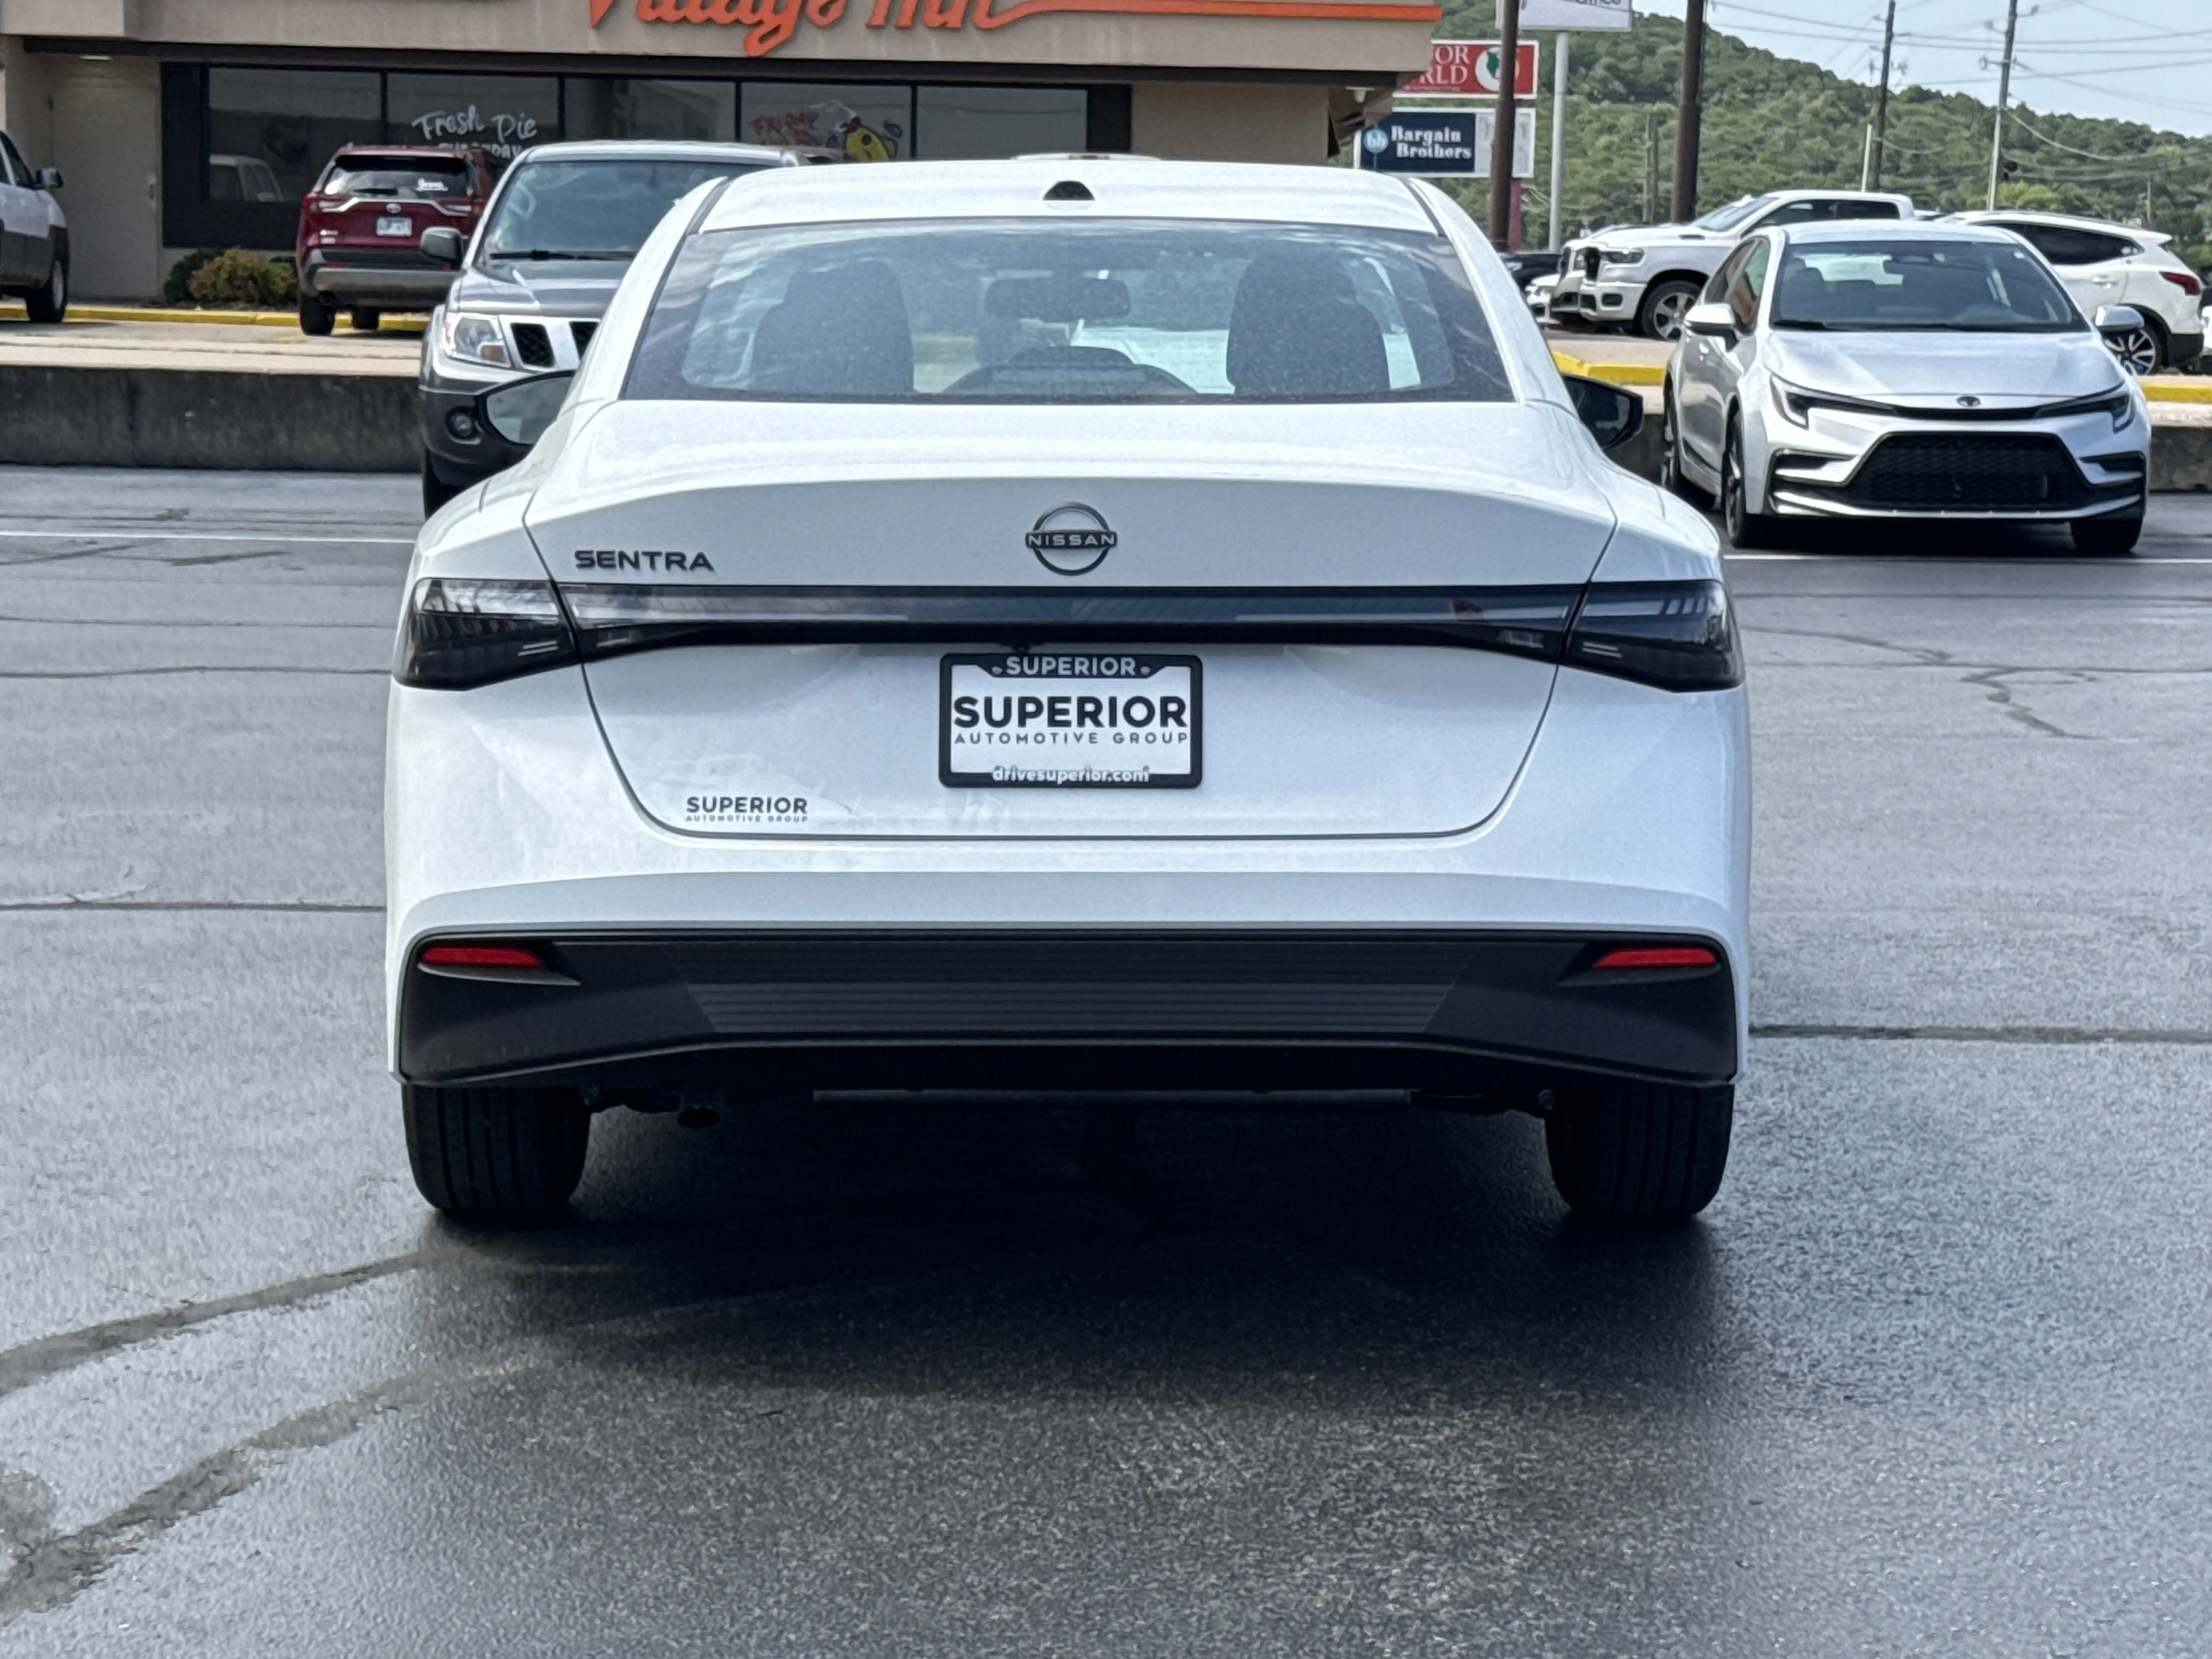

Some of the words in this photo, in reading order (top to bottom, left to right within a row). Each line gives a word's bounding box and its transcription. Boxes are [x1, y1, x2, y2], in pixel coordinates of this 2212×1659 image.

[1431, 45, 1470, 65] OR
[1420, 65, 1468, 84] RLD
[411, 104, 486, 141] Fresh
[490, 111, 538, 144] Pie
[1391, 126, 1461, 146] Bargain
[1396, 143, 1472, 159] Brothers
[1027, 534, 1116, 547] NISSAN
[574, 549, 715, 572] SENTRA
[1006, 656, 1136, 676] SUPERIOR
[953, 695, 1188, 729] SUPERIOR
[954, 732, 1099, 745] AUTOMOTIVE
[1113, 732, 1188, 745] GROUP
[992, 766, 1150, 785] drivesuperior.com
[686, 795, 808, 815] SUPERIOR
